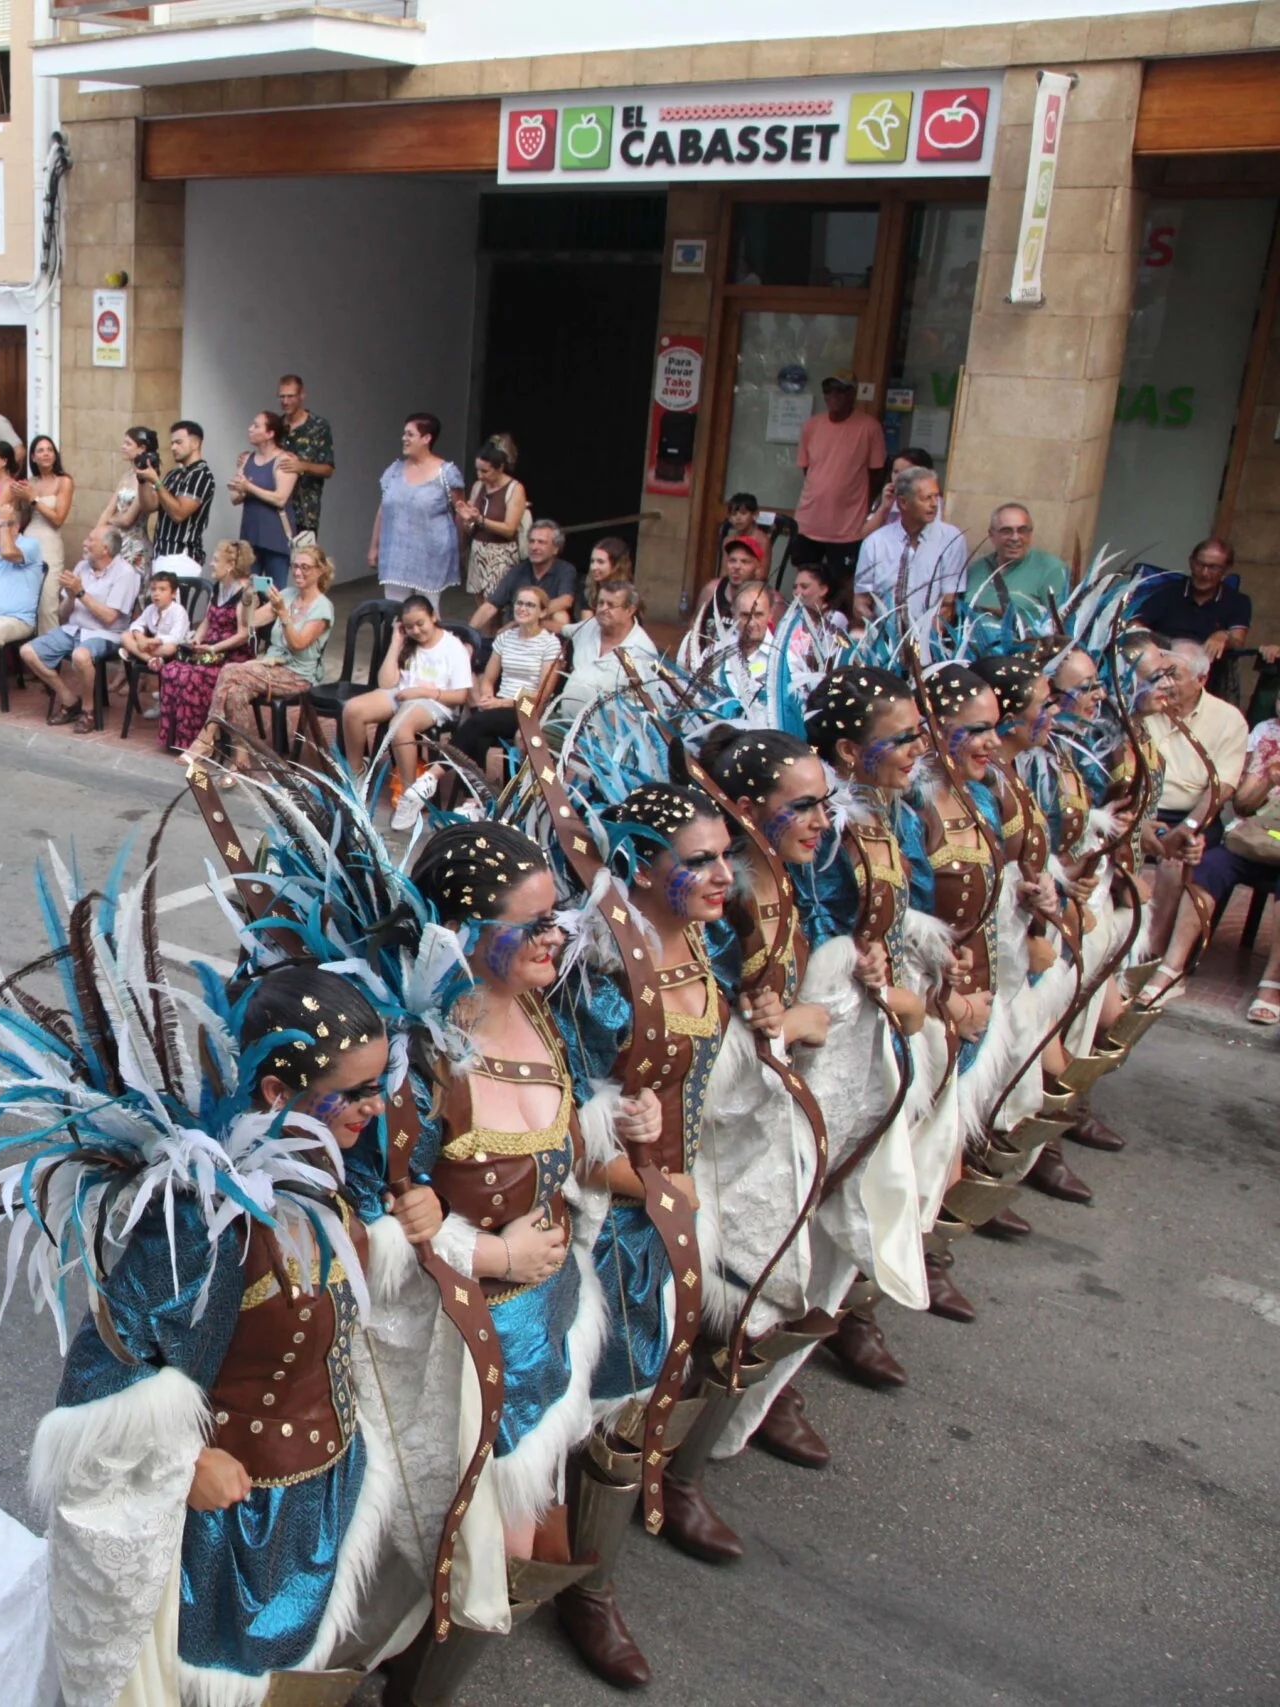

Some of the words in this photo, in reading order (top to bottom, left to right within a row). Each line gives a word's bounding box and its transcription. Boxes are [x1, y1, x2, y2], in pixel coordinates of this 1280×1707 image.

[622, 105, 647, 128] EL
[620, 124, 840, 166] CABASSET
[668, 357, 692, 367] Para
[664, 366, 694, 376] llevar
[665, 377, 692, 388] Take
[662, 387, 692, 399] away
